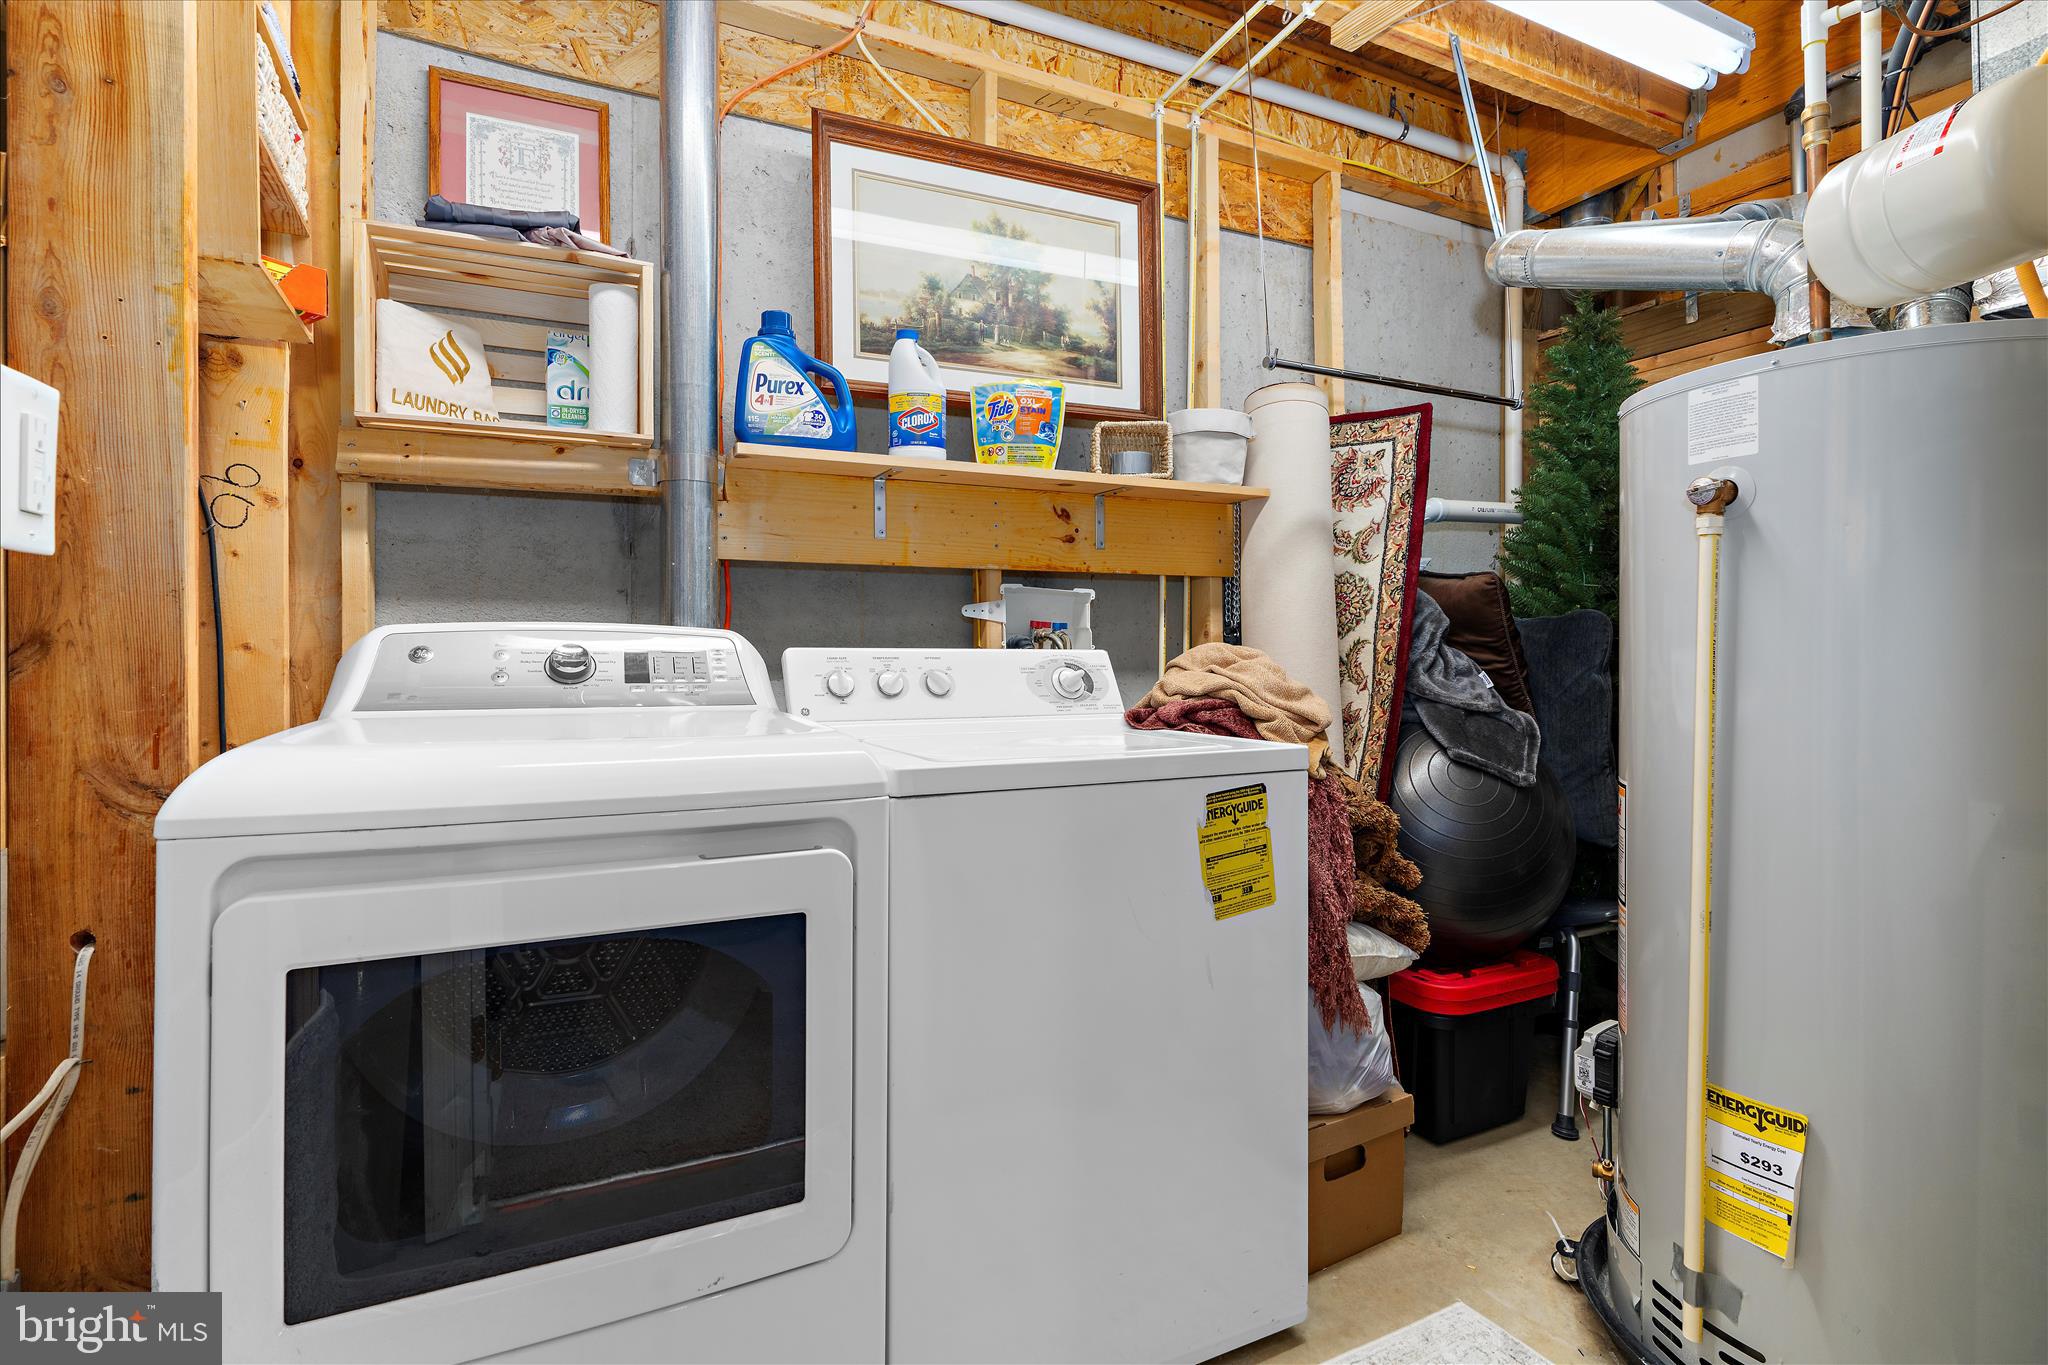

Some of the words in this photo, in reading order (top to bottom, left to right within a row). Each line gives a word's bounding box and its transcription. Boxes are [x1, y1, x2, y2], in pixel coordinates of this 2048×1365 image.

[754, 373, 805, 396] Purex
[391, 387, 468, 420] LAUNDRY
[561, 407, 587, 415] IN-DRYER
[988, 399, 1015, 421] Tide
[1020, 406, 1046, 415] STAIN
[561, 413, 587, 421] CLEANING
[901, 412, 935, 428] CLOROX
[1740, 1152, 1783, 1176] $293
